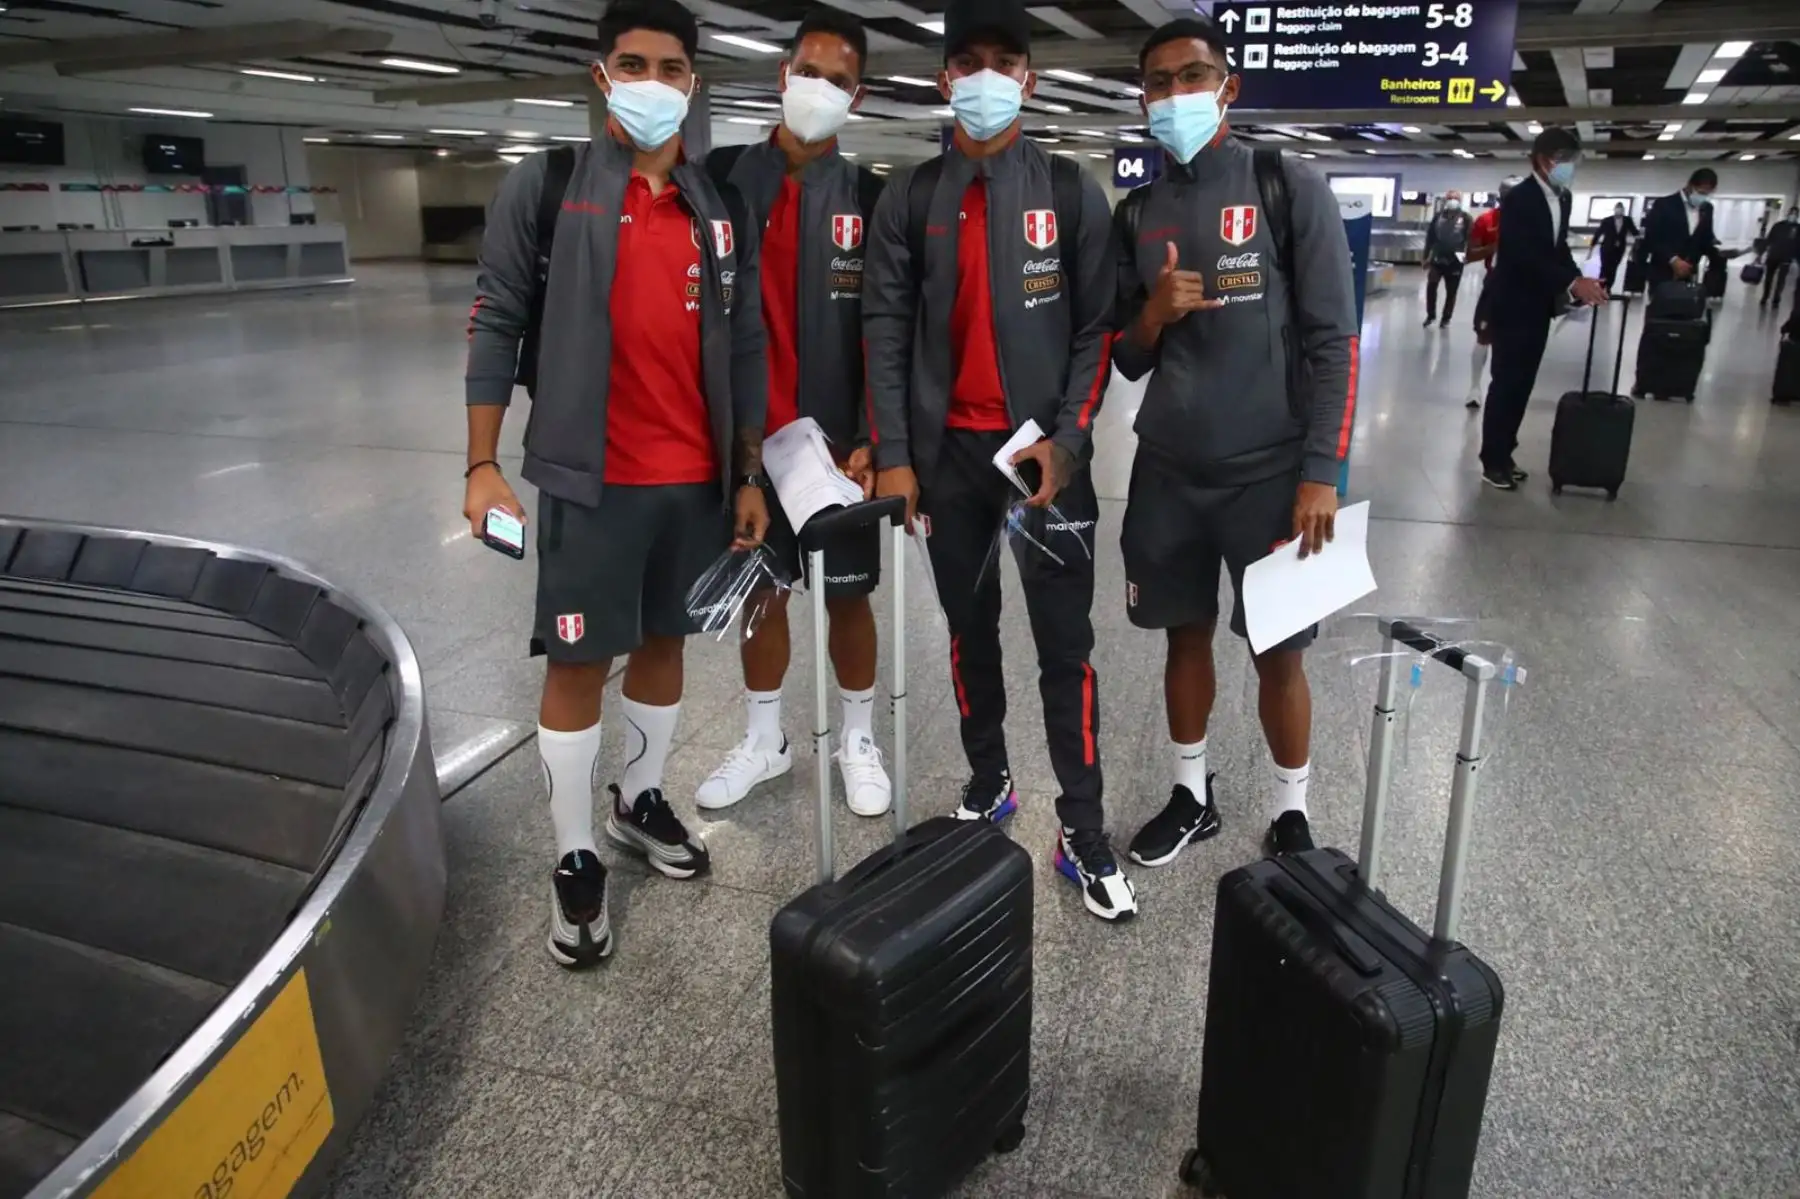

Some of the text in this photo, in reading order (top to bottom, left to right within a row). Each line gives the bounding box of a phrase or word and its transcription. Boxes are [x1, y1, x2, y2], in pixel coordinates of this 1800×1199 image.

[1277, 4, 1420, 20] Restituição de bagagem
[1425, 3, 1473, 29] 5-8
[1276, 21, 1342, 34] Baggage claim
[1274, 41, 1416, 57] Restituição de bagagem
[1421, 42, 1469, 67] 3-4
[1273, 58, 1340, 71] Baggage claim
[1381, 78, 1442, 91] Banheiros
[1390, 94, 1440, 104] Restrooms
[1117, 157, 1145, 178] 04
[1231, 292, 1264, 303] movistar
[824, 572, 869, 585] marathon
